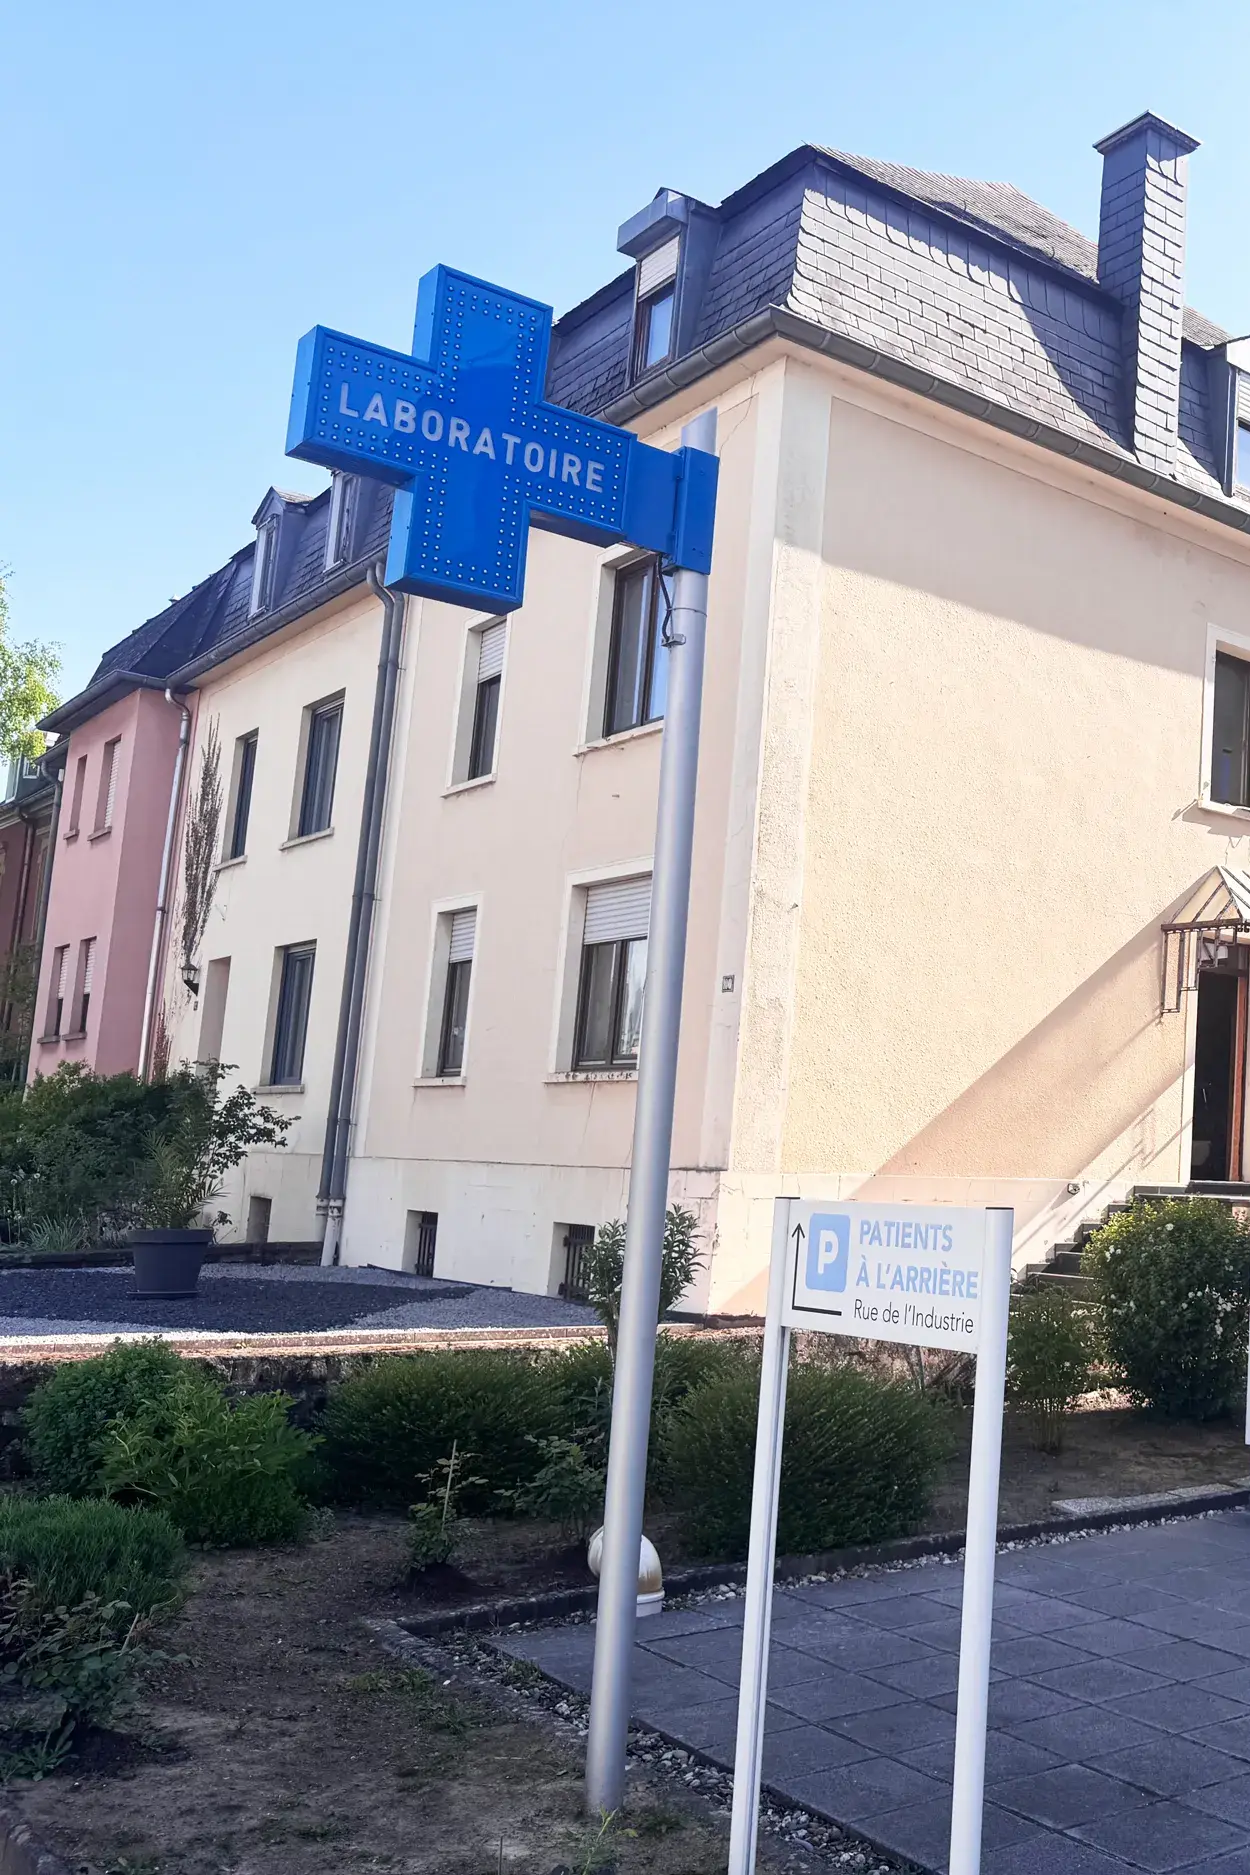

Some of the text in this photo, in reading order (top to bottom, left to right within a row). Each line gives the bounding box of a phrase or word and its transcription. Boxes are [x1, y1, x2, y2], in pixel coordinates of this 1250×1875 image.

[338, 381, 606, 494] LABORATOIRE
[817, 1229, 839, 1275] P
[859, 1219, 953, 1252] PATIENTS
[856, 1254, 870, 1288] À
[854, 1298, 879, 1322] Rue
[882, 1301, 900, 1324] de
